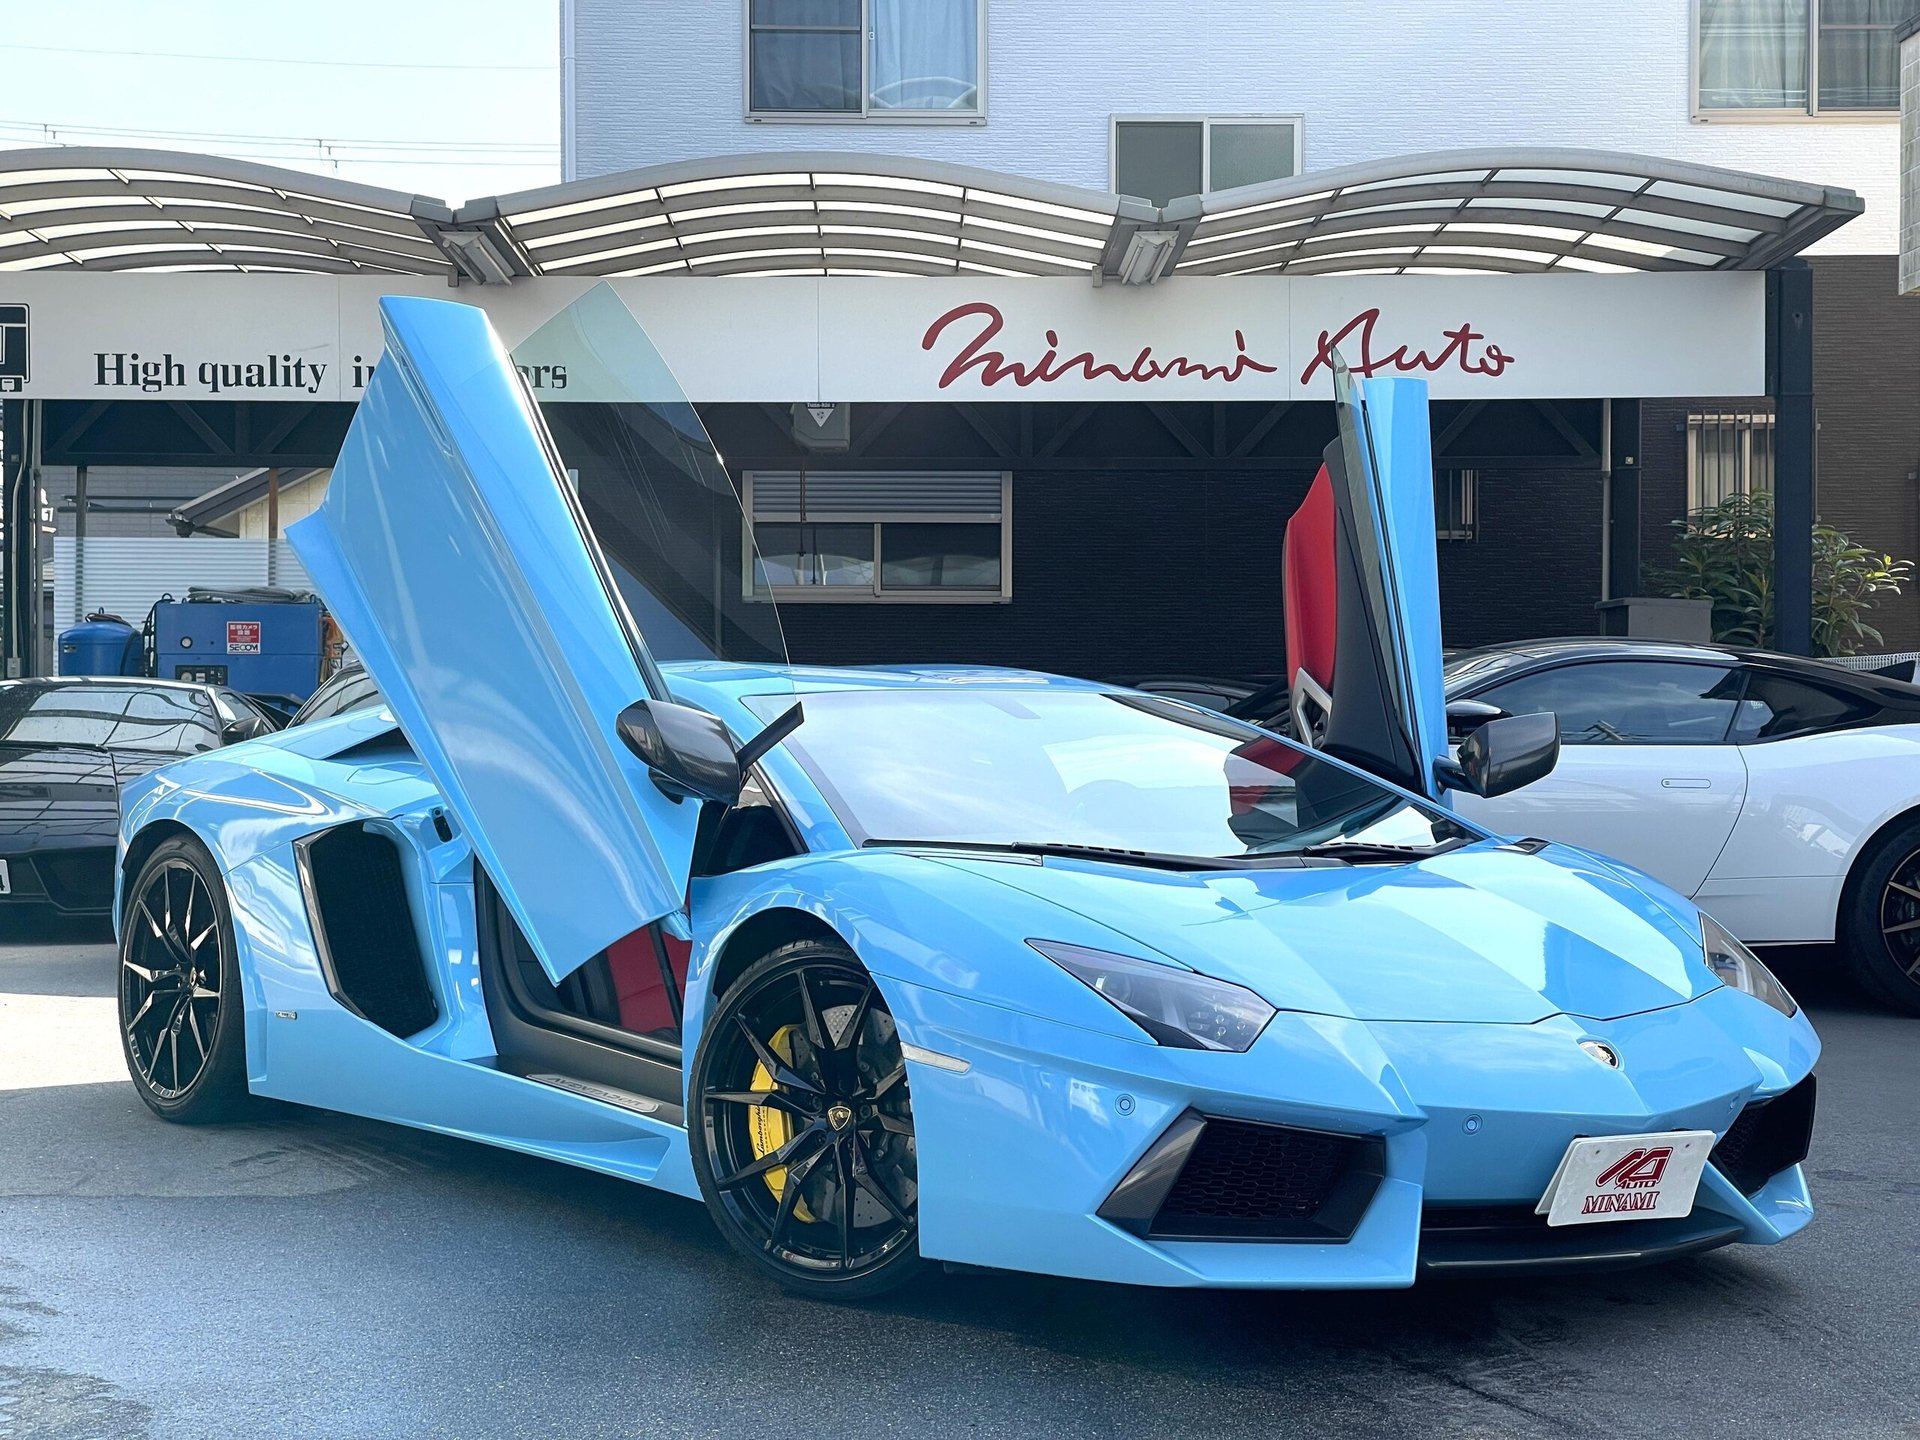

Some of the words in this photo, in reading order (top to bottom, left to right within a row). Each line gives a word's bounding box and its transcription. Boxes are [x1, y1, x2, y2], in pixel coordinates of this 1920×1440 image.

[921, 301, 1277, 389] Minami
[1300, 307, 1516, 386] Auto
[93, 352, 188, 393] High
[198, 353, 328, 394] quality
[229, 643, 258, 652] SECOM
[1581, 1191, 1660, 1214] MINAMI
